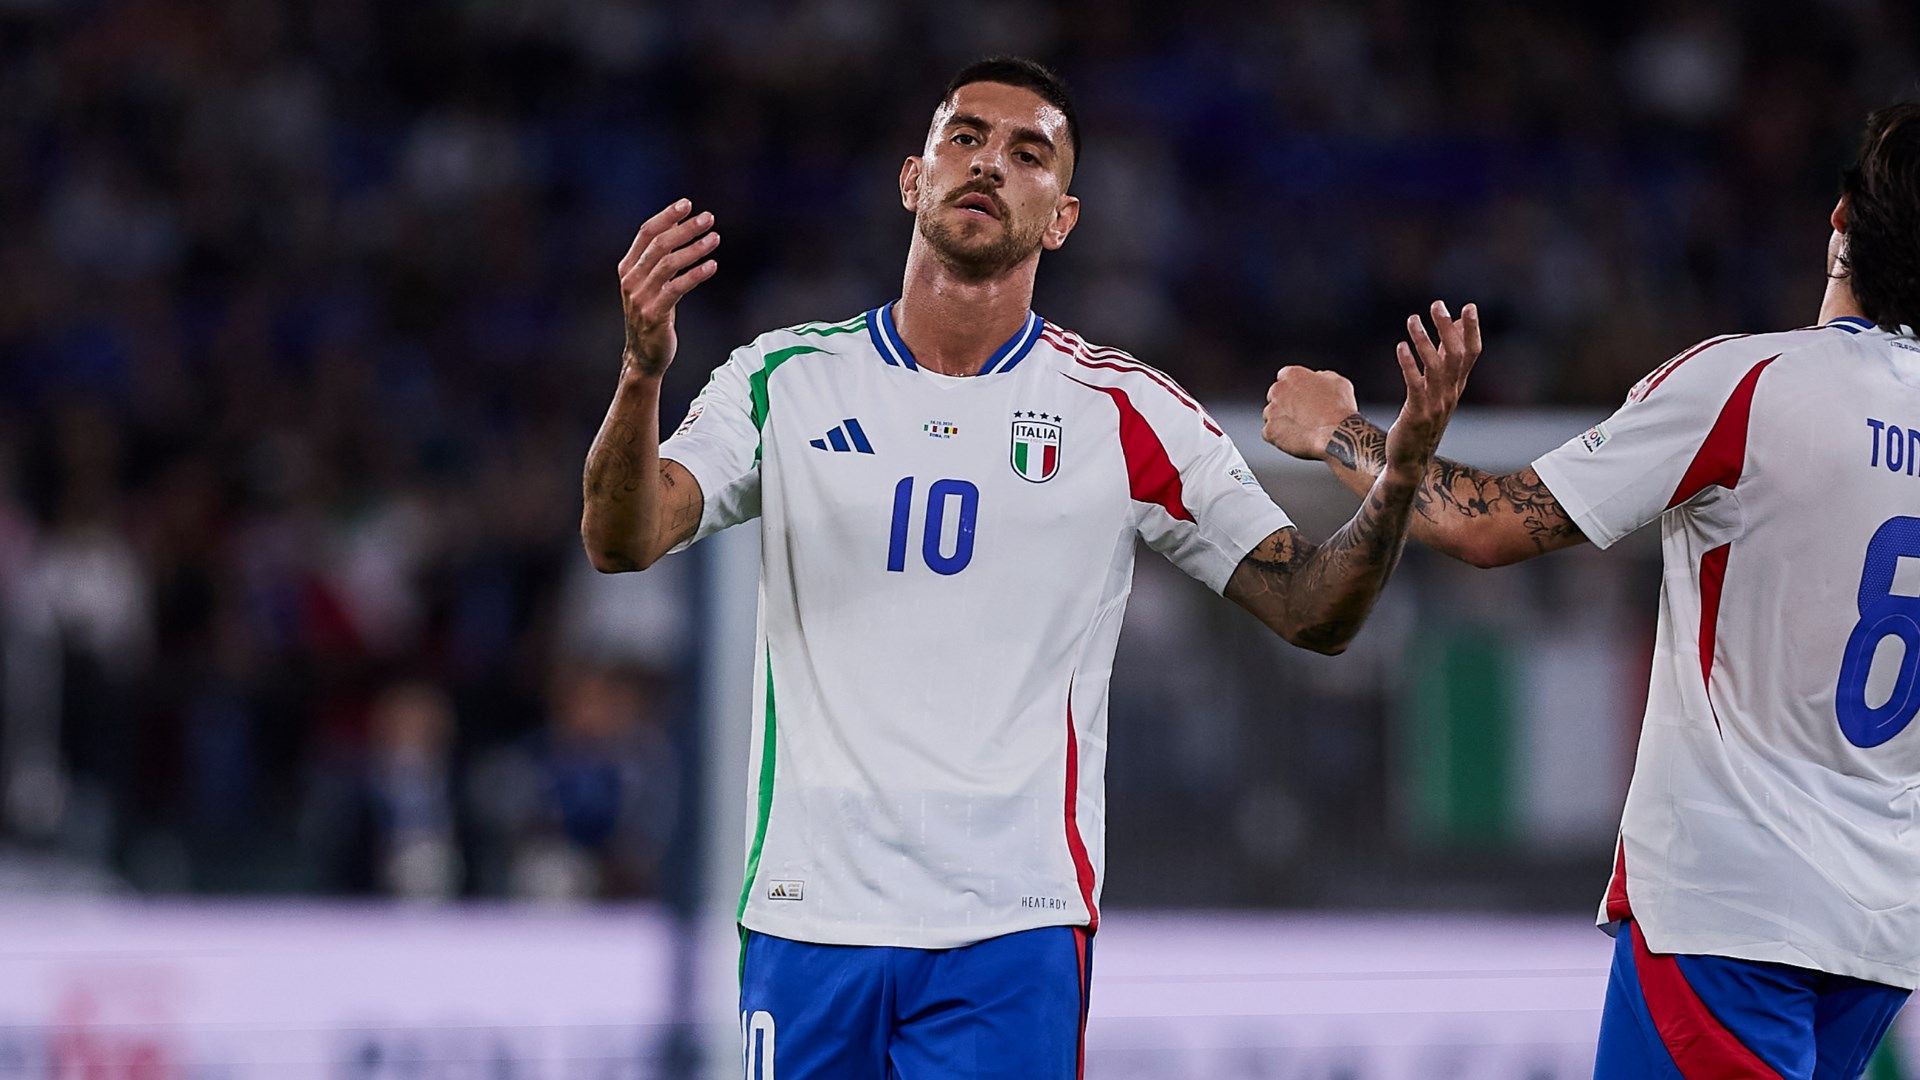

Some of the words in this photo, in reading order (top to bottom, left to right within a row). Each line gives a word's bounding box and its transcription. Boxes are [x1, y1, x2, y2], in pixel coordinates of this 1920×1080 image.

[1016, 425, 1056, 440] ITALIA
[1867, 418, 1920, 478] TON
[887, 476, 980, 576] 10
[1835, 515, 1920, 749] 8
[1021, 896, 1067, 910] HEAT.RDY
